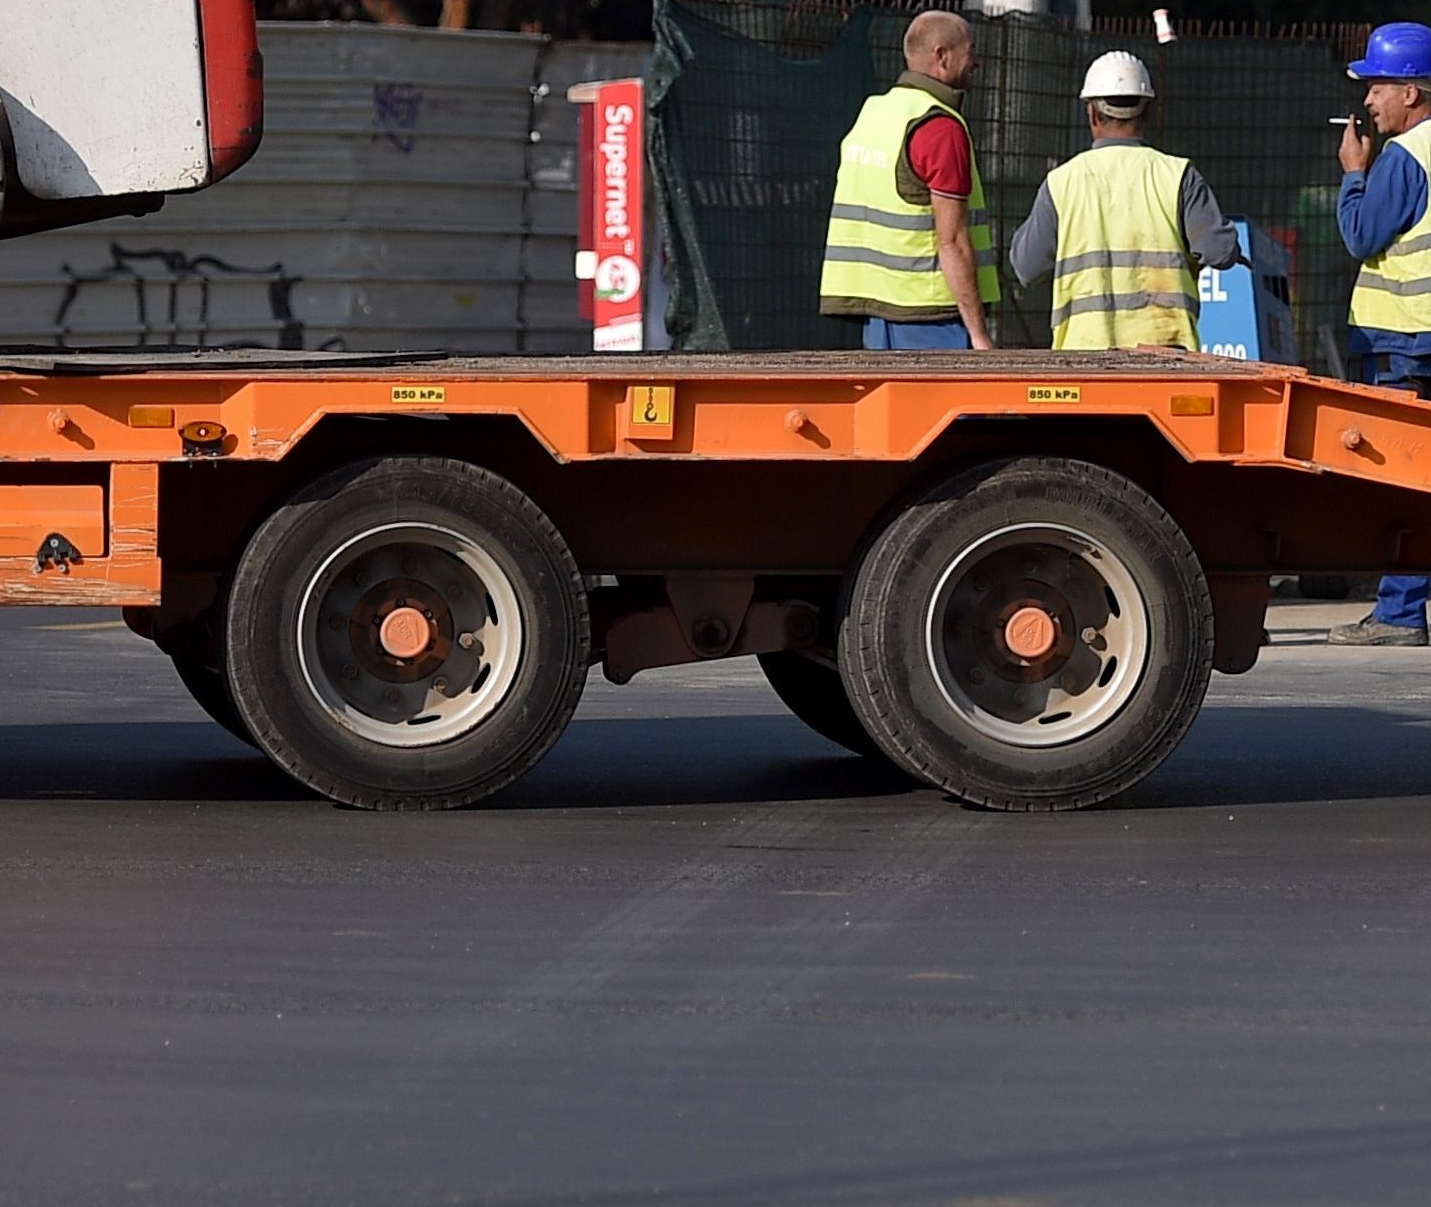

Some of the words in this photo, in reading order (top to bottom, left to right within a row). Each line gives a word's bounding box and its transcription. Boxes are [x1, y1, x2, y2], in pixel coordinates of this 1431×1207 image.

[600, 104, 635, 240] Supernet
[393, 389, 416, 400] 850
[419, 389, 443, 400] kPa
[1029, 389, 1052, 400] 850
[1055, 389, 1078, 400] kPa
